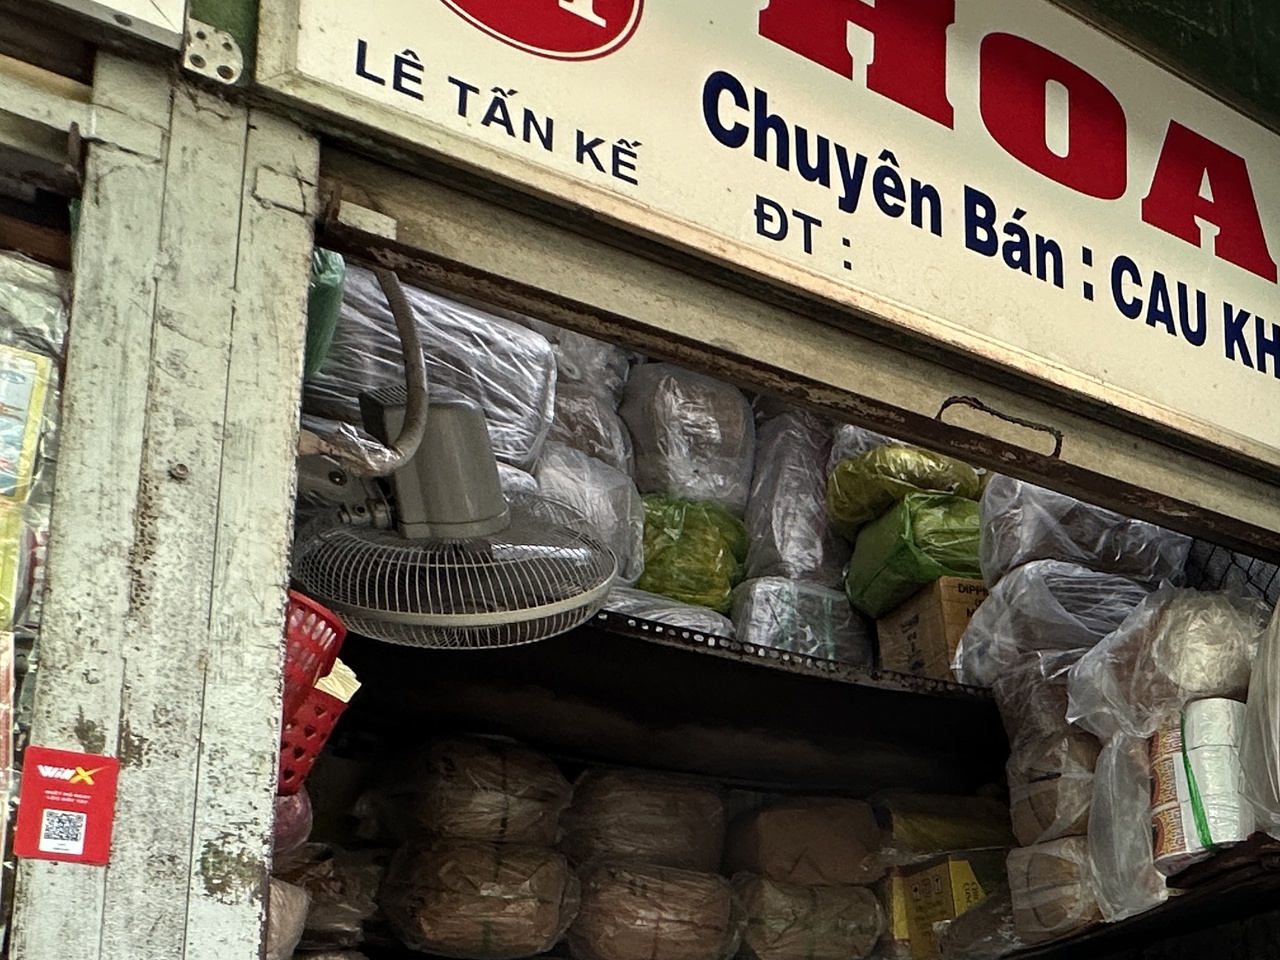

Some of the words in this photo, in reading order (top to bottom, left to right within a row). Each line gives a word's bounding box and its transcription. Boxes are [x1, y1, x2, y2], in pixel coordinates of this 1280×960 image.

[356, 39, 424, 101] LÊ
[448, 76, 553, 152] TẤN
[576, 129, 642, 185] KẾ
[702, 71, 942, 237] Chuyên
[964, 184, 1064, 289] Bán
[1111, 255, 1206, 347] CAU
[759, 0, 1277, 284] HOA
[754, 194, 822, 255] ĐT
